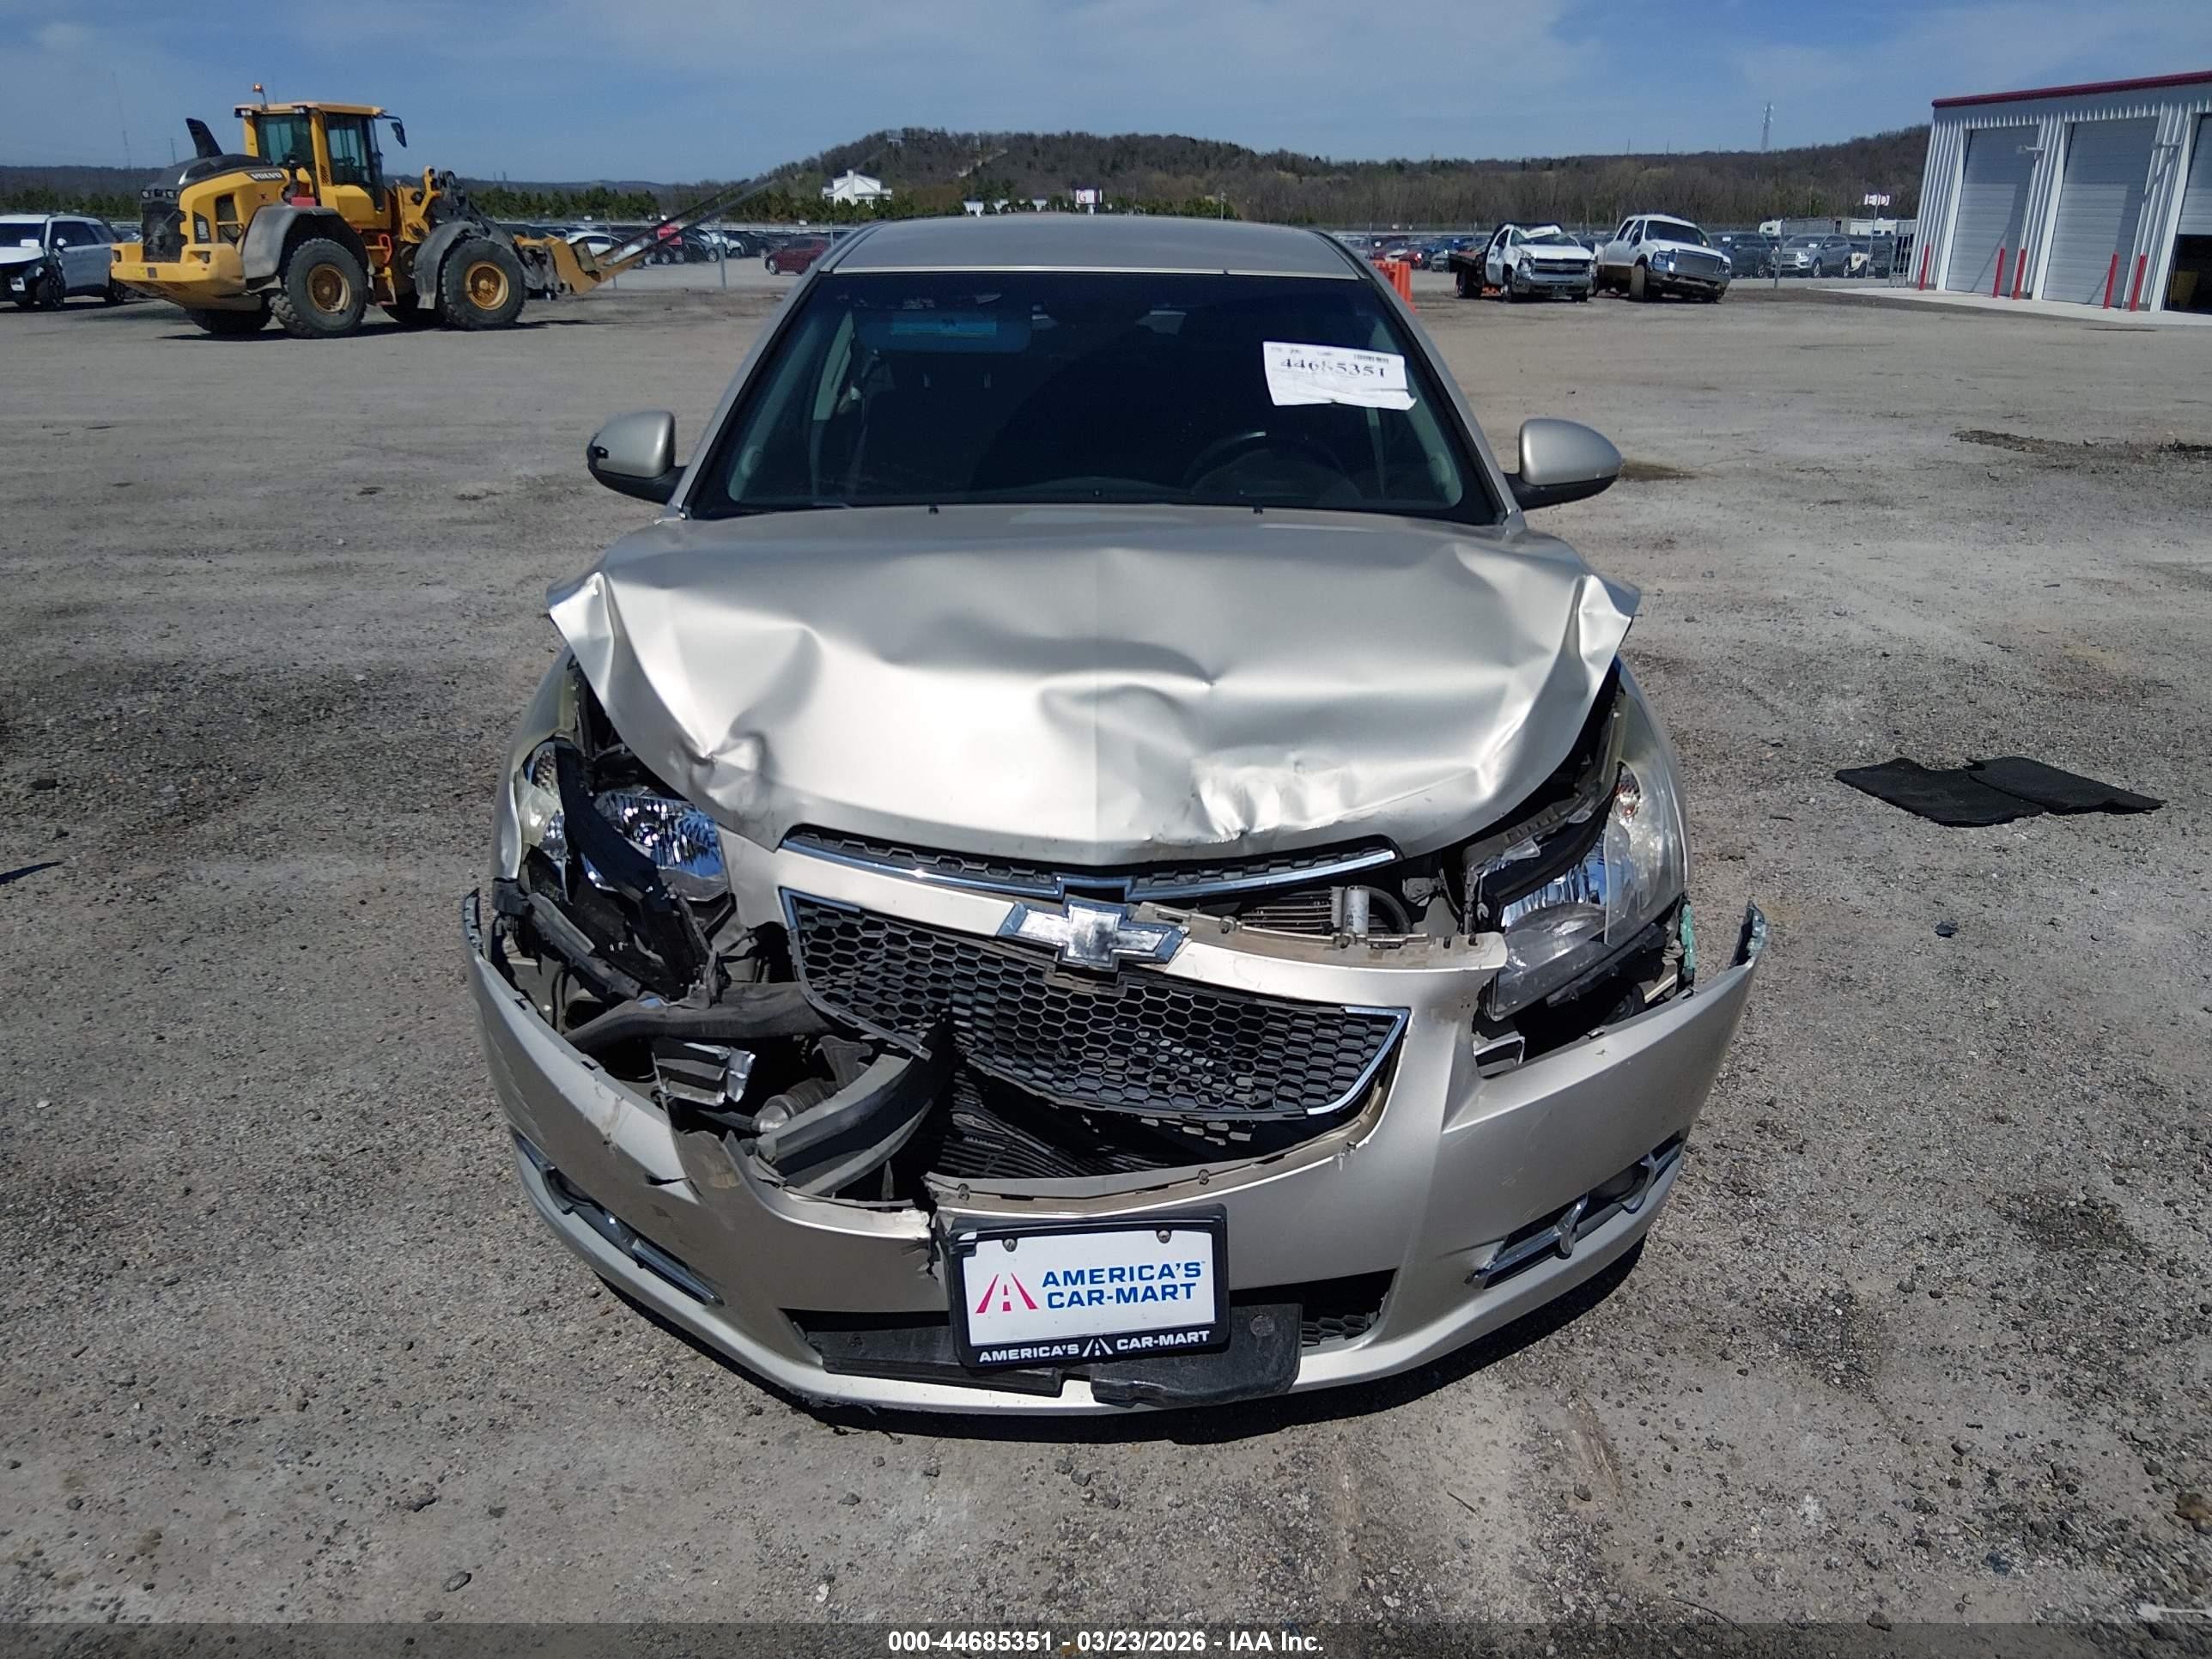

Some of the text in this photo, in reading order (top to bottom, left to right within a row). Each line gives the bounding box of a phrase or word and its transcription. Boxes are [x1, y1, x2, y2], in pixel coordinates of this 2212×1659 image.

[1042, 1261, 1201, 1287] AMERICA'S
[1047, 1283, 1196, 1309] CAR-MART
[979, 1330, 1210, 1363] AMERICA'S CAR-MART
